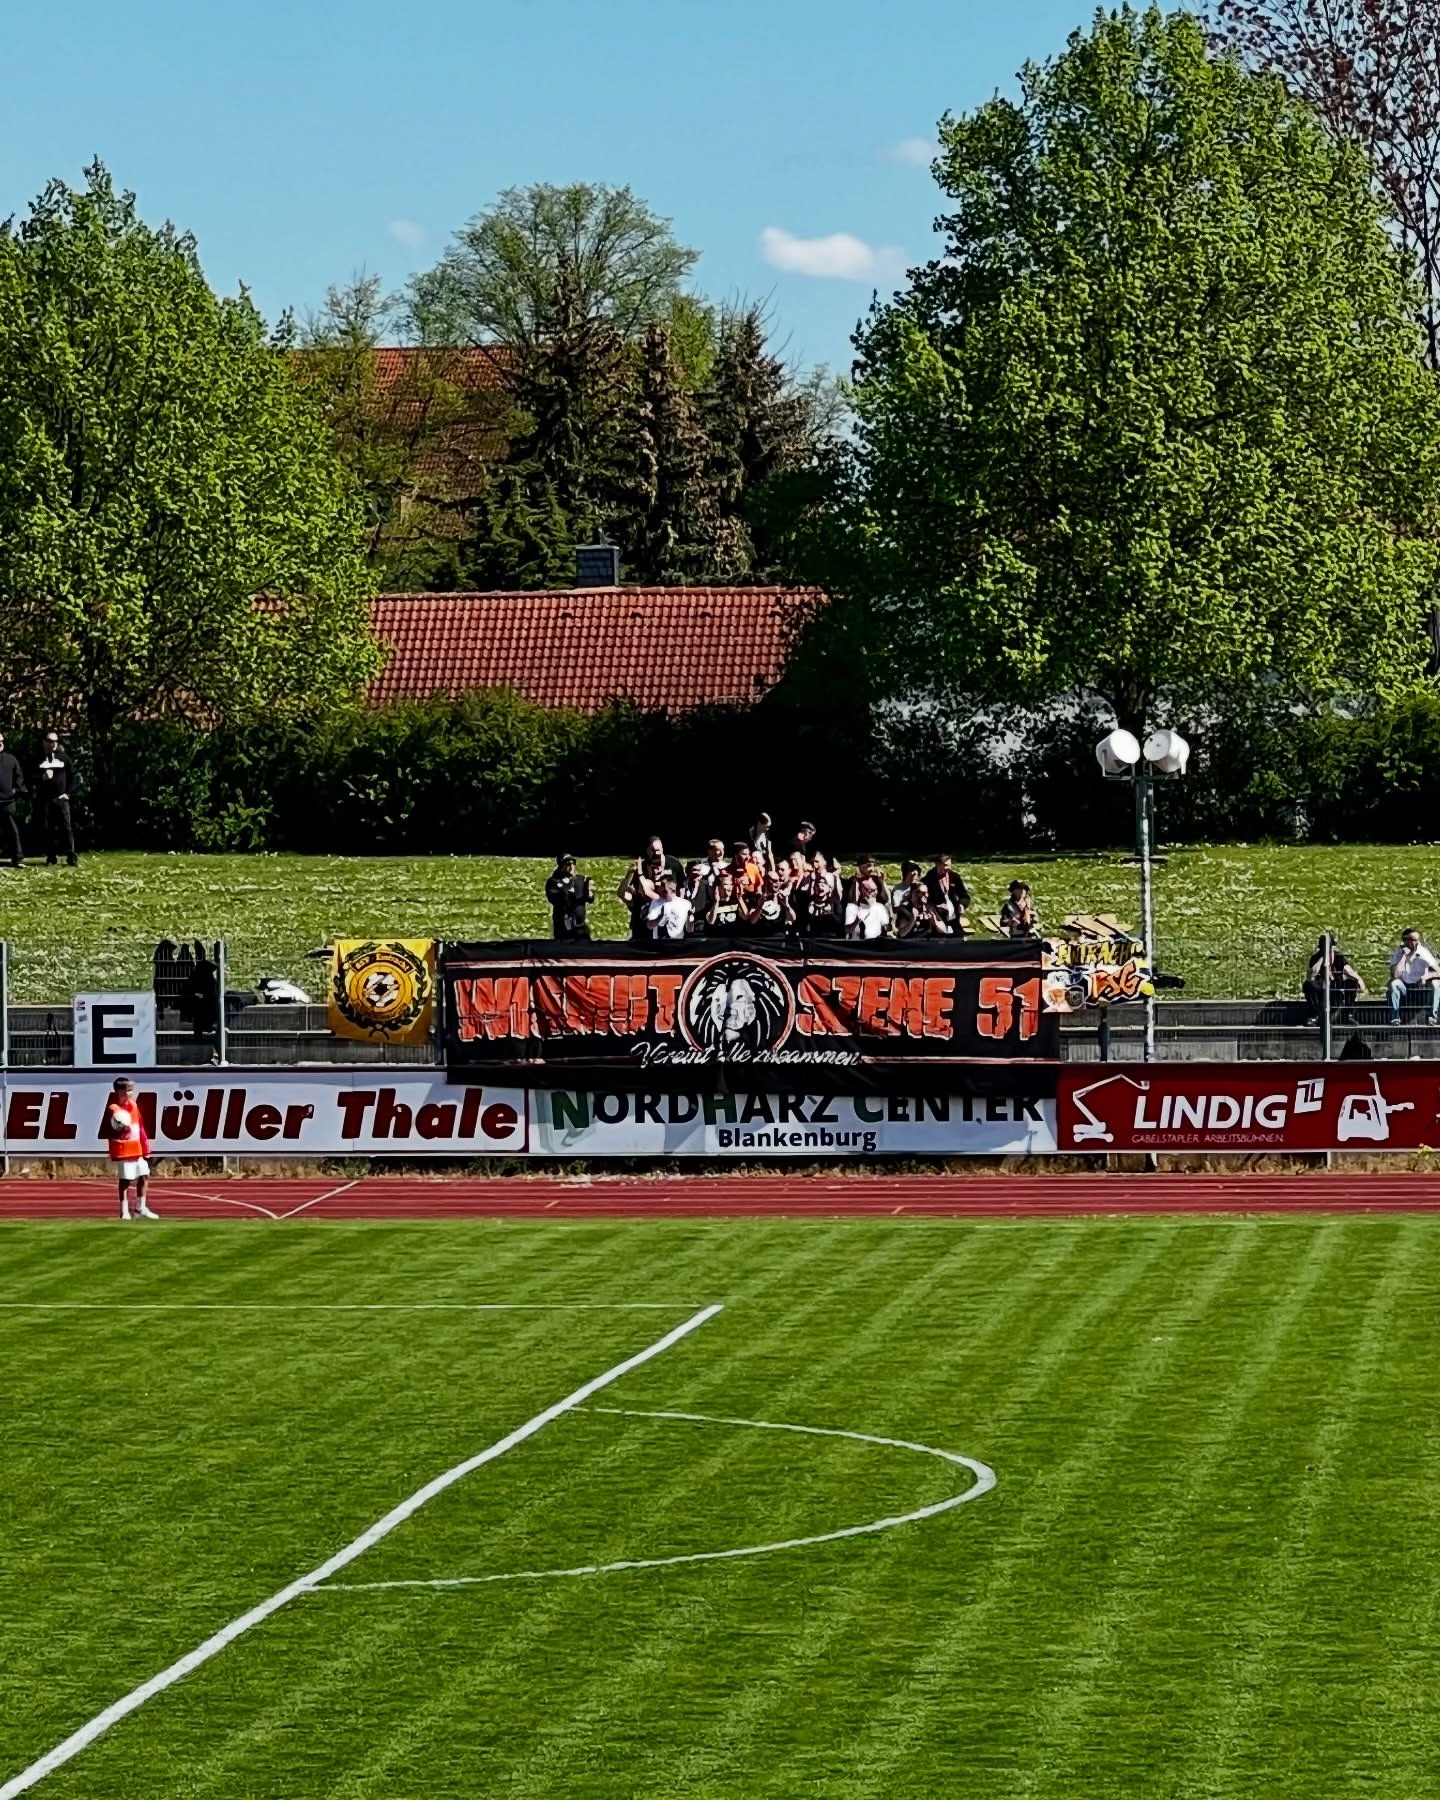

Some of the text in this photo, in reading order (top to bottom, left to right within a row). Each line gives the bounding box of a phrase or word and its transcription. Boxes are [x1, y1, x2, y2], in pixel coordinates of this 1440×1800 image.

[976, 976, 1041, 1041] 51
[91, 1004, 137, 1065] E
[336, 1087, 519, 1140] Thale
[550, 1091, 839, 1131] NORDHARZ
[1133, 1094, 1289, 1129] LINDIG
[718, 1126, 877, 1151] Blankenburg
